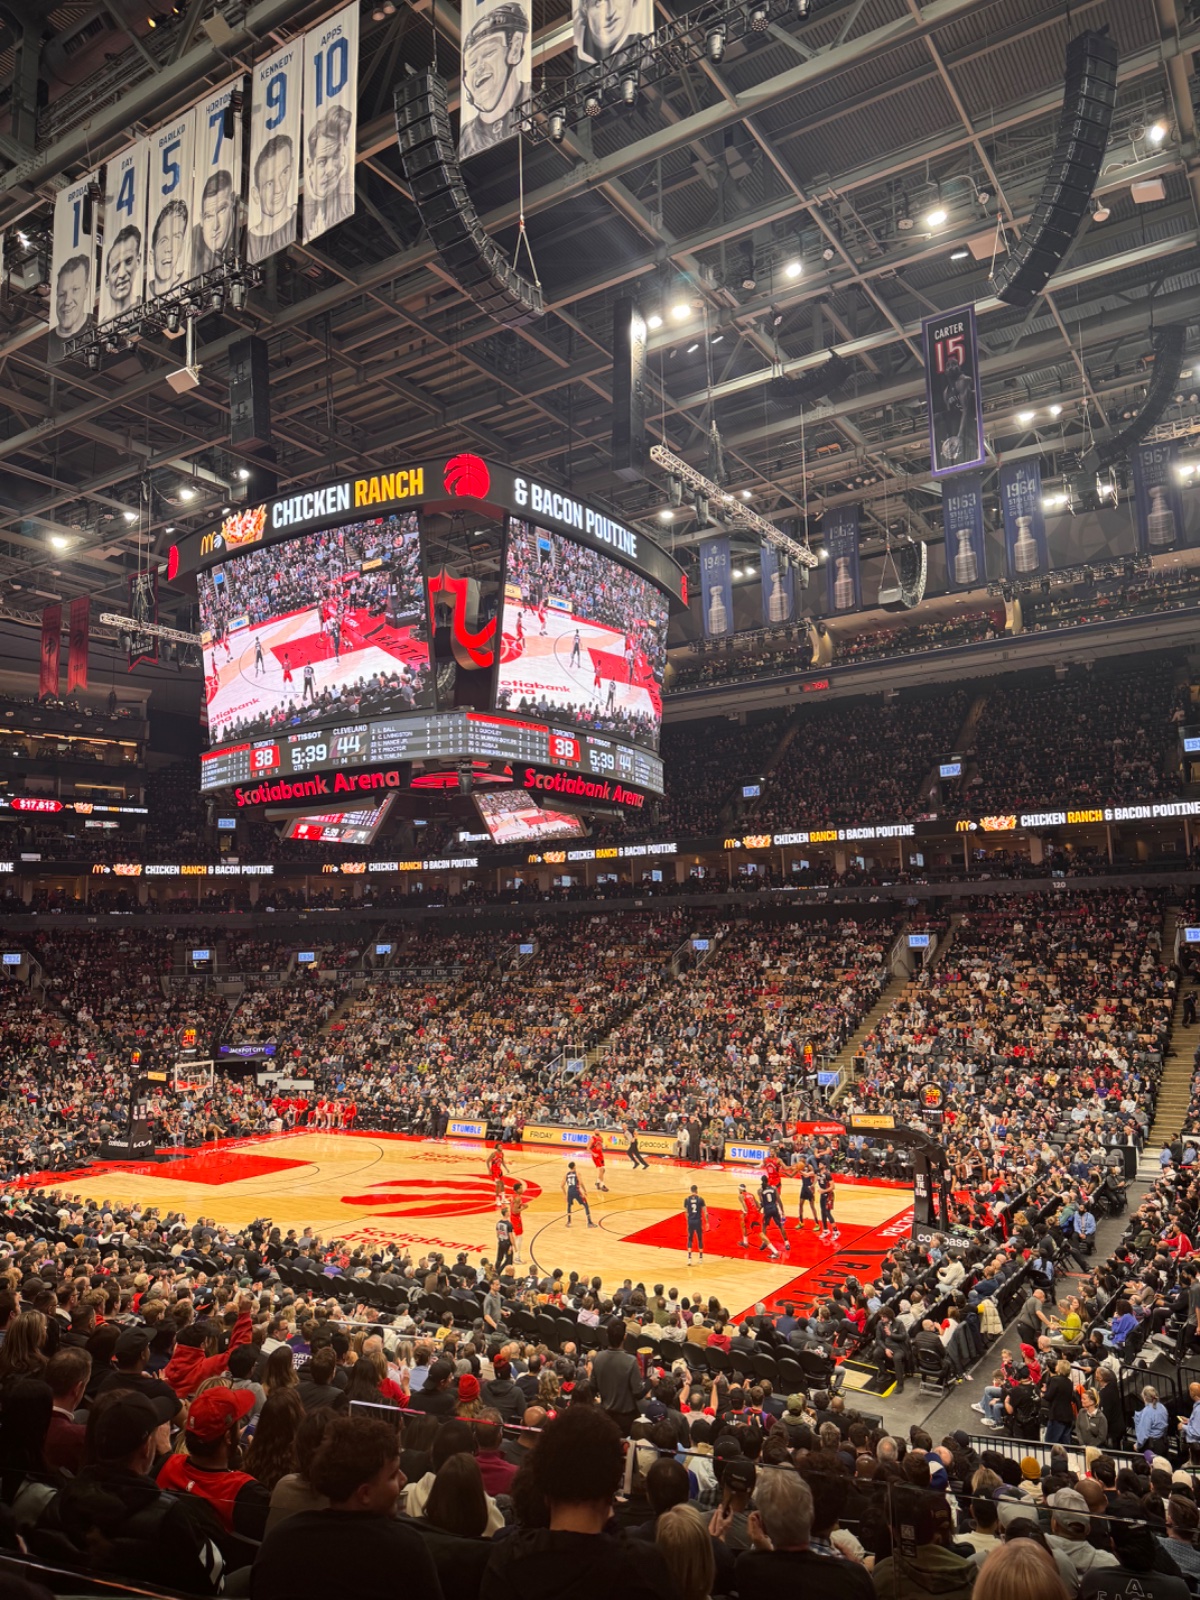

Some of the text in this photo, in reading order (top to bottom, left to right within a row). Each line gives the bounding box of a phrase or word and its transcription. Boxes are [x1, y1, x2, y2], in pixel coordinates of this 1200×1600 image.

[320, 25, 343, 47] APPS
[260, 51, 294, 81] KENNEDY
[313, 36, 349, 107] 10
[265, 72, 288, 131] 9
[158, 124, 186, 148] BARILKO
[209, 109, 225, 166] 7
[121, 155, 133, 170] DAY
[162, 139, 181, 196] 5
[116, 166, 135, 216] 4
[72, 200, 81, 249] 1
[934, 322, 964, 341] CARTER
[933, 334, 966, 374] 15
[272, 467, 425, 528] CHICKEN RANCH
[1006, 478, 1036, 499] 1964
[947, 492, 977, 512] 1963
[514, 477, 638, 559] & BACON POUTINE
[297, 731, 322, 741] TISSOT
[333, 724, 368, 736] CLEVELAND
[291, 743, 327, 765] 5:39
[336, 735, 361, 754] 44
[555, 738, 574, 757] 38
[255, 748, 273, 768] 38
[589, 749, 615, 769] 5:39
[620, 753, 631, 771] 44
[941, 764, 961, 776] IBM
[234, 771, 400, 807] Scotiabank Arena
[524, 768, 611, 800] Scotiabank
[612, 784, 645, 808] Arena
[19, 799, 55, 811] $17,612
[1020, 801, 1200, 827] CHICKEN RANCH & BACON POUTINE
[773, 824, 915, 845] CHICKEN RANCH & BACON POUTINE
[567, 850, 595, 861] CHICKEN
[595, 848, 618, 859] RANCH
[624, 845, 647, 857] BACON
[647, 843, 678, 855] POUTINE
[145, 864, 274, 875] CHICKEN RANCH & BACON POUTINE
[368, 861, 399, 872] CHICKEN
[399, 861, 422, 871] RANCH
[429, 859, 450, 870] BACON
[450, 858, 479, 869] POUTINE
[910, 935, 929, 946] IBM
[182, 1034, 195, 1047] 24
[451, 1123, 482, 1134] STUMBLE
[529, 1130, 554, 1139] FRIDAY
[562, 1132, 590, 1144] STUMB
[639, 1140, 670, 1149] peacock
[731, 1147, 769, 1159] STUMBL
[691, 1203, 698, 1213] 2
[358, 1227, 493, 1253] Scotiabank
